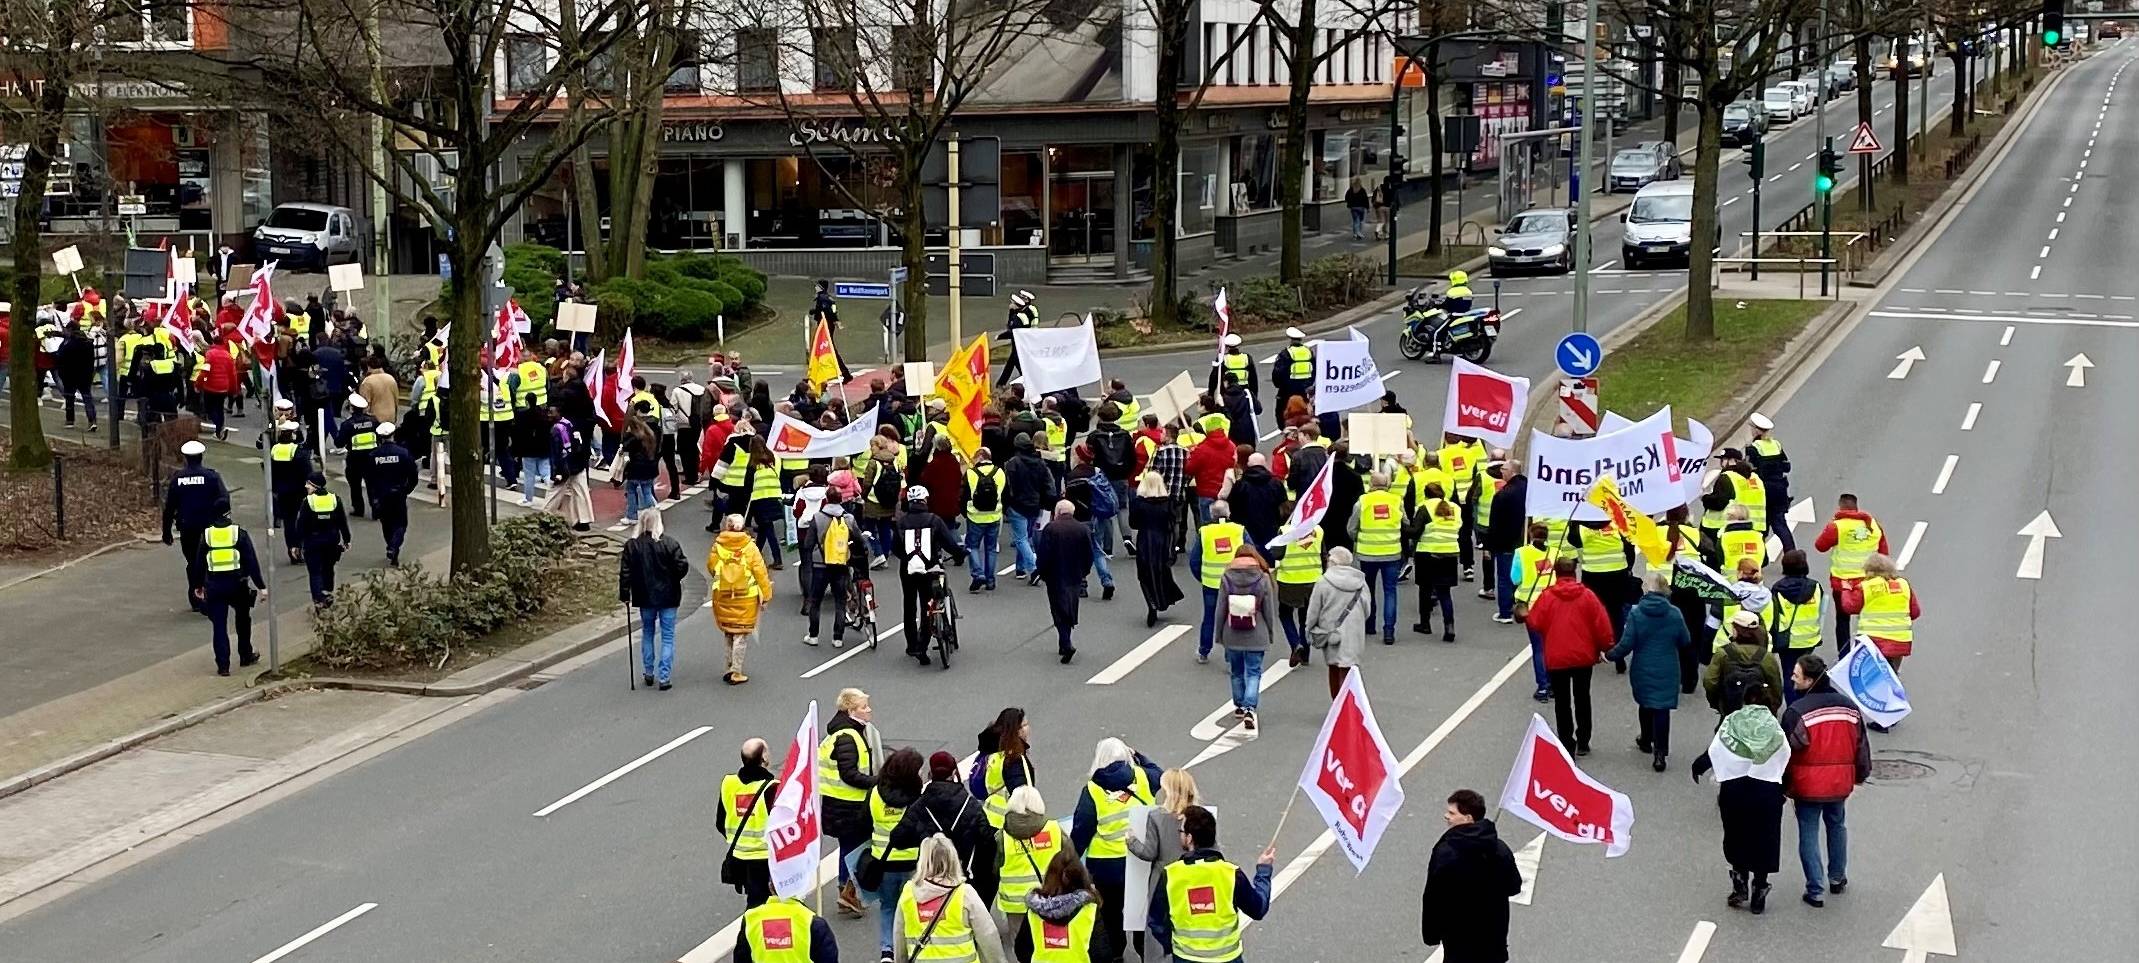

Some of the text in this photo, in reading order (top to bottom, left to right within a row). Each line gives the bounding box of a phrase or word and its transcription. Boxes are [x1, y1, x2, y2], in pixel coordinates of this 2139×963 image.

[663, 124, 724, 142] PIANO
[374, 455, 399, 464] POLIZEI
[177, 475, 205, 486] POLIZEI
[765, 936, 792, 948] ver.di
